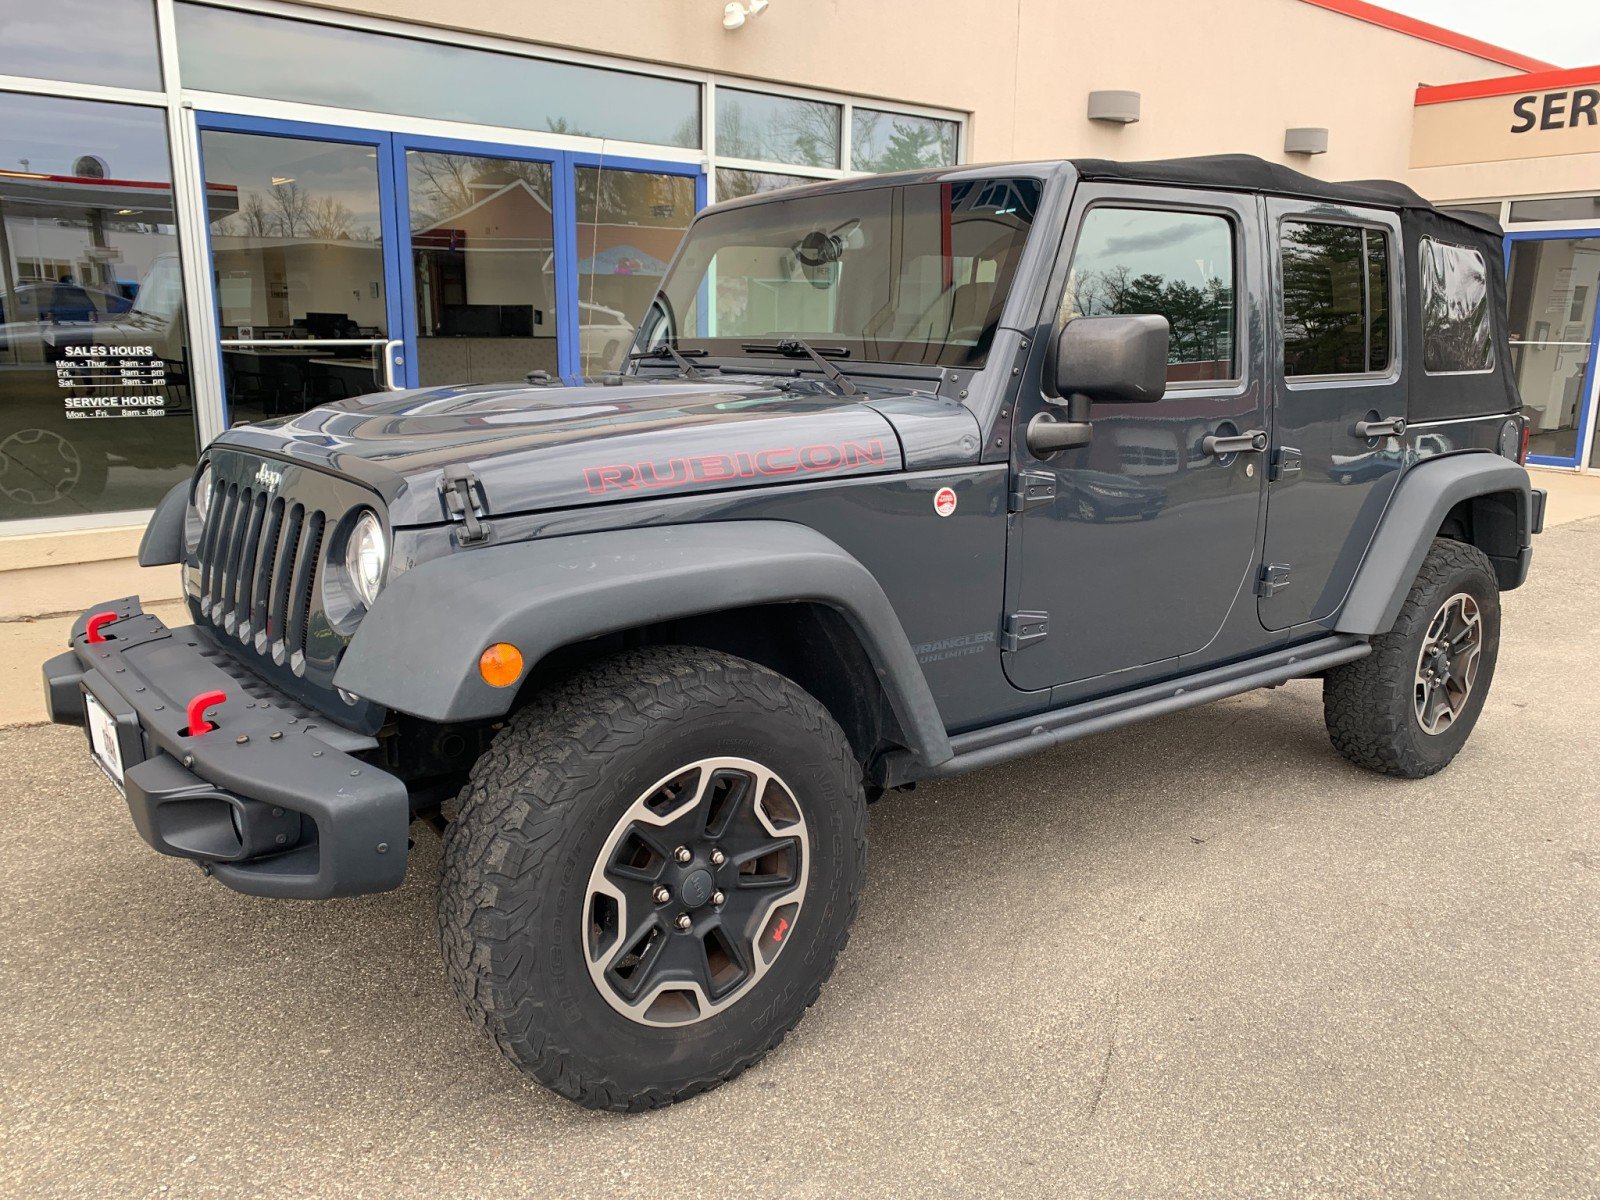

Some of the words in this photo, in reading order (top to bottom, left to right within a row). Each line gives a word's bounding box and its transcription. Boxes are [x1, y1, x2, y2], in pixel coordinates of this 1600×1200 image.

[1510, 88, 1600, 133] SER
[64, 346, 106, 356] SALES
[110, 346, 153, 356] HOURS
[55, 360, 76, 368] Mon.
[57, 369, 72, 377] Fri.
[58, 379, 76, 387] Sat.
[64, 396, 119, 407] SERVICE
[121, 396, 164, 406] HOURS
[147, 408, 165, 417] 6pm
[582, 440, 886, 495] RUBICON
